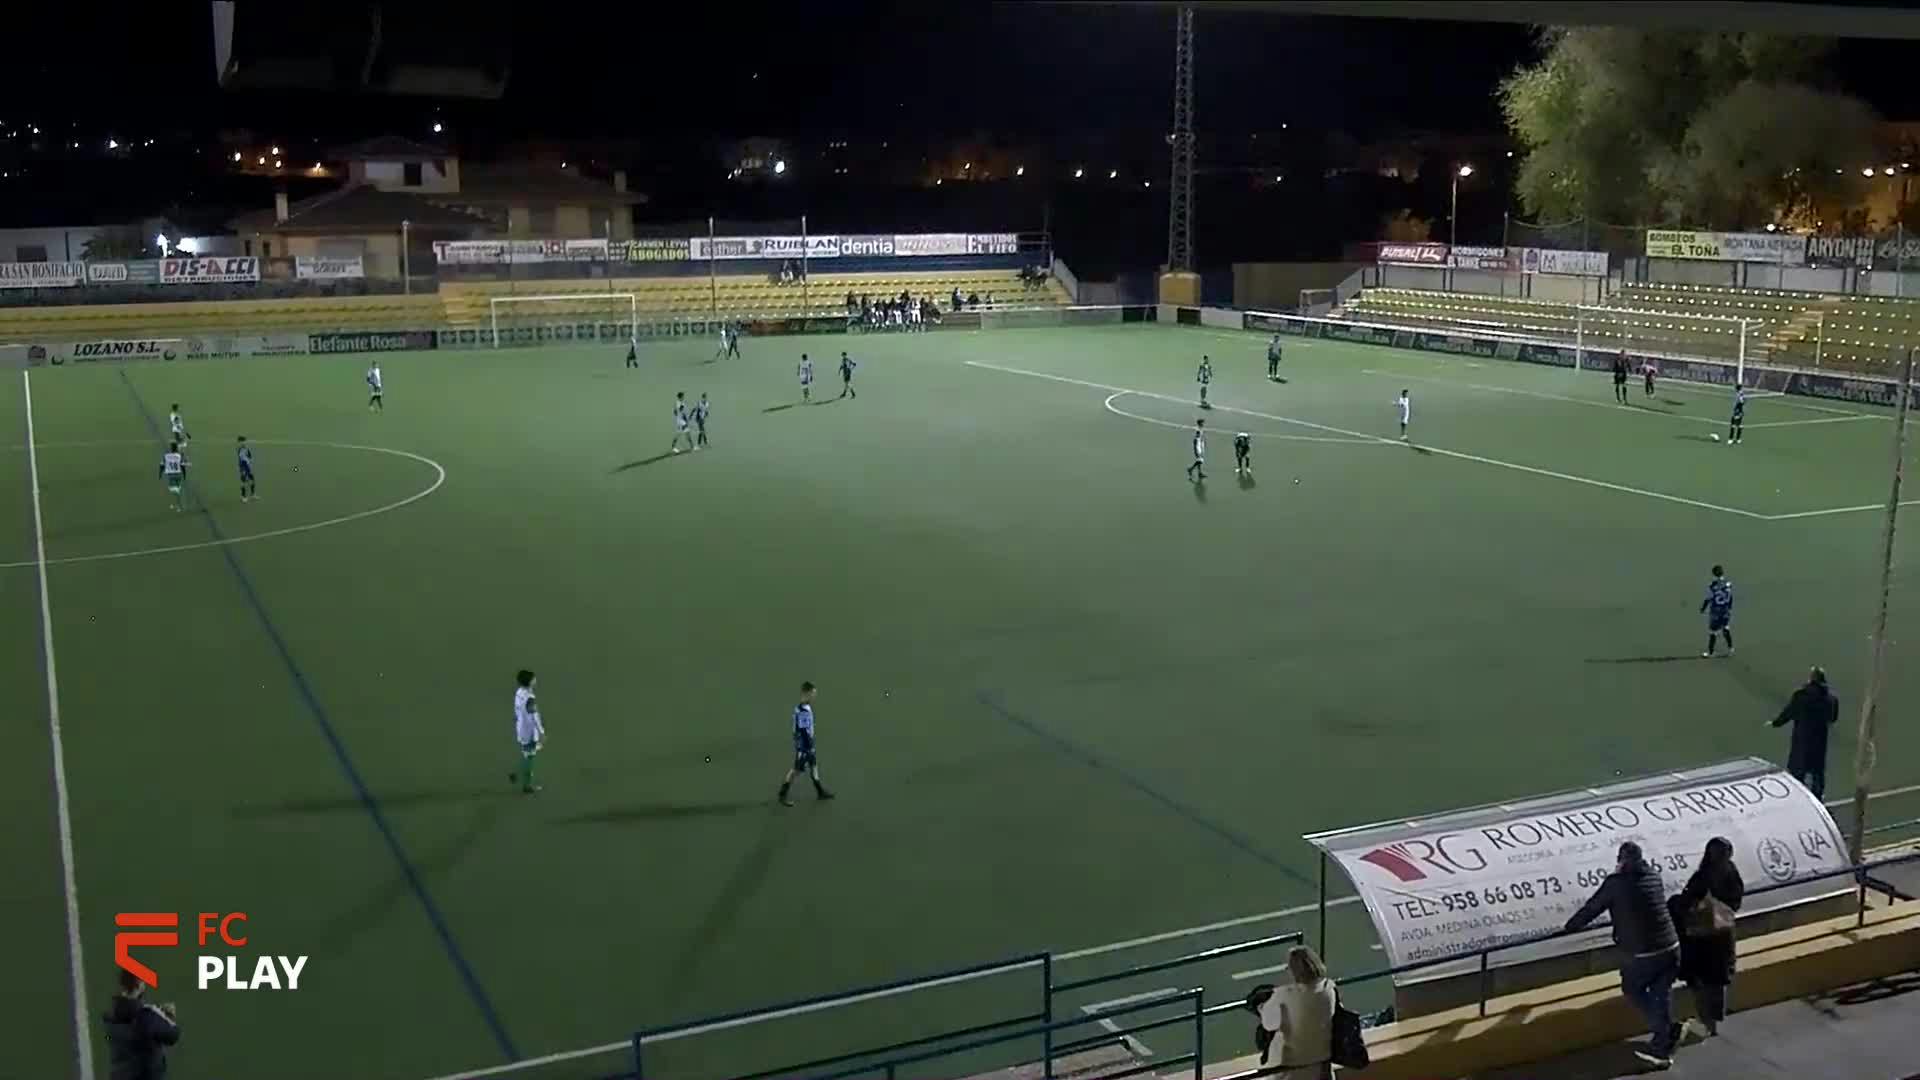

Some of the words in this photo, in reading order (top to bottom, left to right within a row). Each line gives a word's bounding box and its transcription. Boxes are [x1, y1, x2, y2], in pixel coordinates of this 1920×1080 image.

[630, 249, 690, 261] ABOGADOS
[841, 238, 893, 255] dentia
[1688, 243, 1720, 257] TOÑA
[73, 342, 134, 357] LOZANO
[310, 336, 369, 353] Elefante
[1482, 805, 1640, 850] ROMERO
[1643, 776, 1791, 822] GARRIDO
[1441, 890, 1480, 912] 958
[1483, 887, 1508, 905] 66
[1510, 880, 1536, 900] 08
[1536, 875, 1562, 896] 73
[1664, 853, 1688, 871] 38
